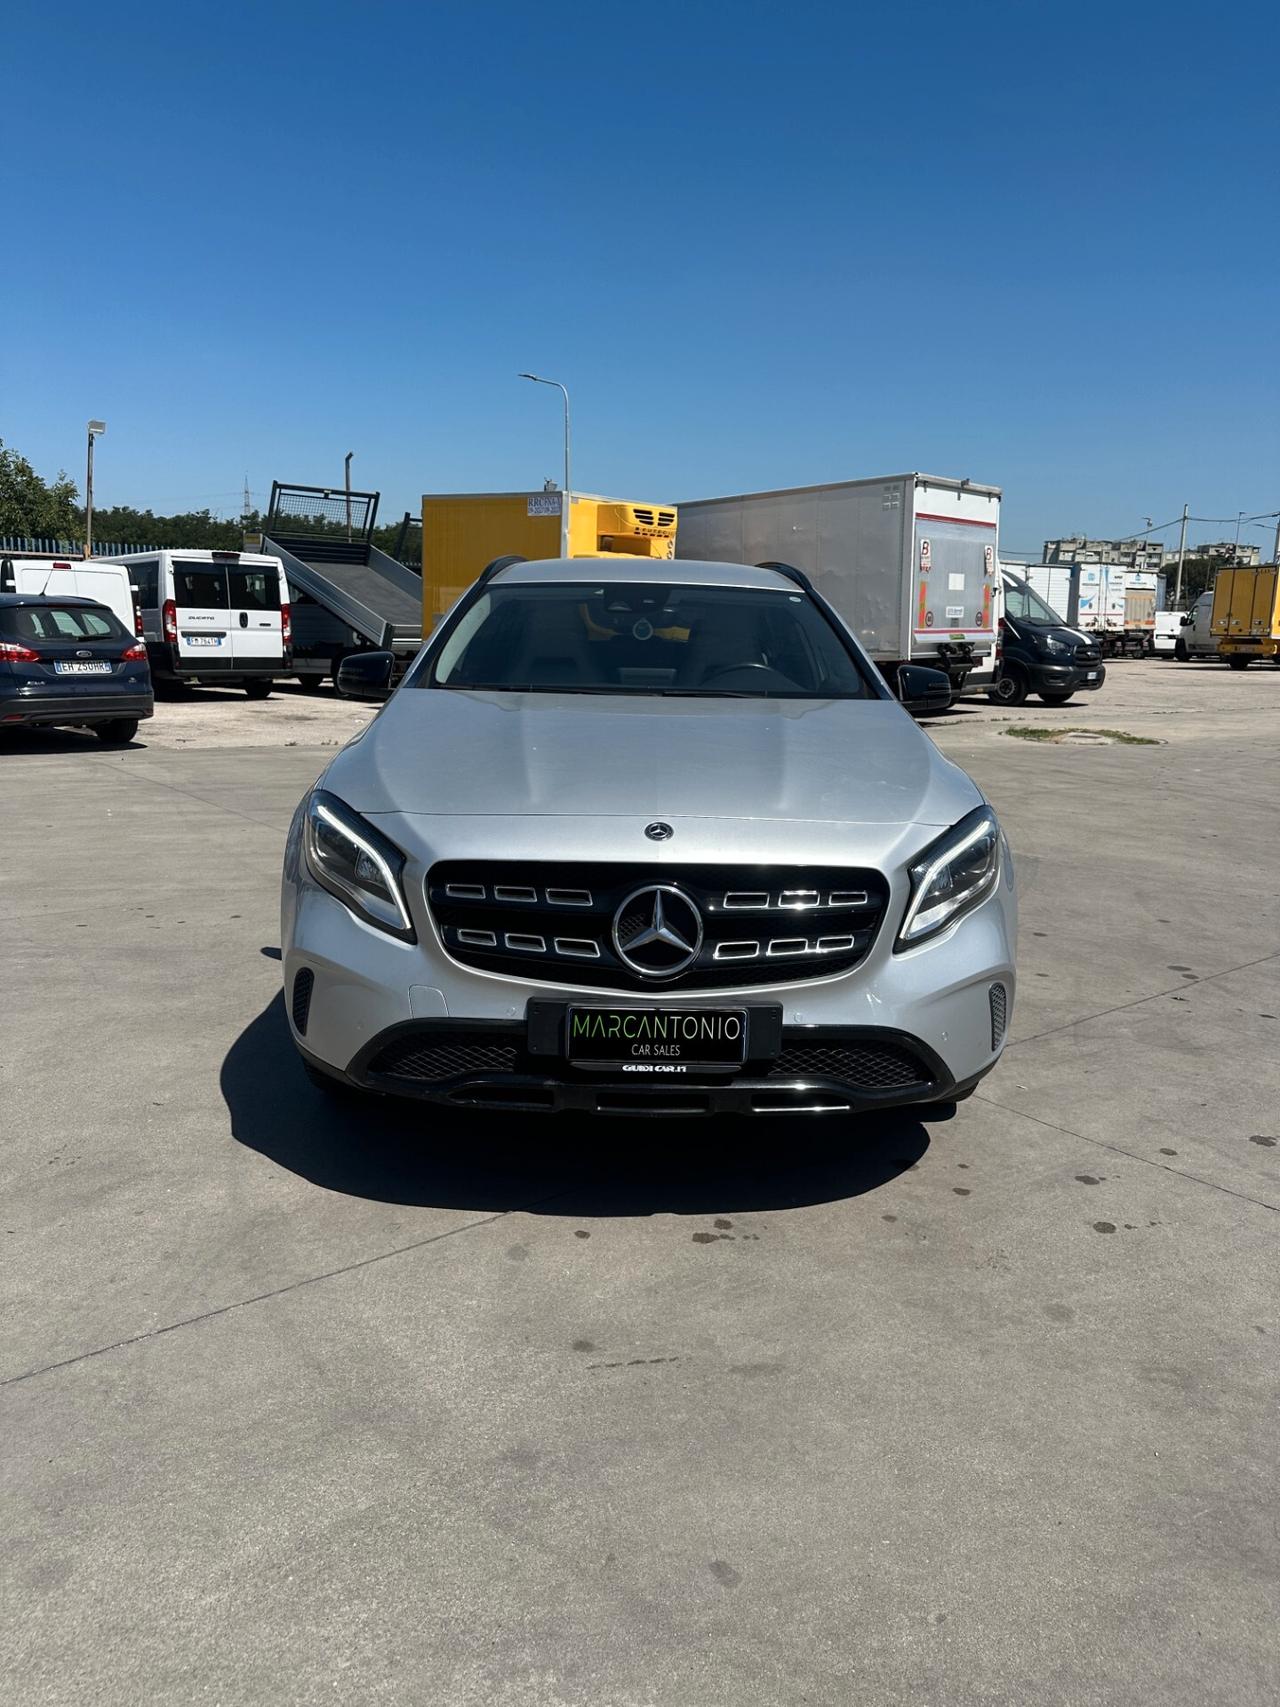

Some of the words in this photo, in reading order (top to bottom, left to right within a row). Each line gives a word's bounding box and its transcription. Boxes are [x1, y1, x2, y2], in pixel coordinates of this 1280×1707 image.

[573, 1015, 740, 1039] MARCANTONIO
[631, 1044, 651, 1056] CAR
[653, 1044, 681, 1056] SALES
